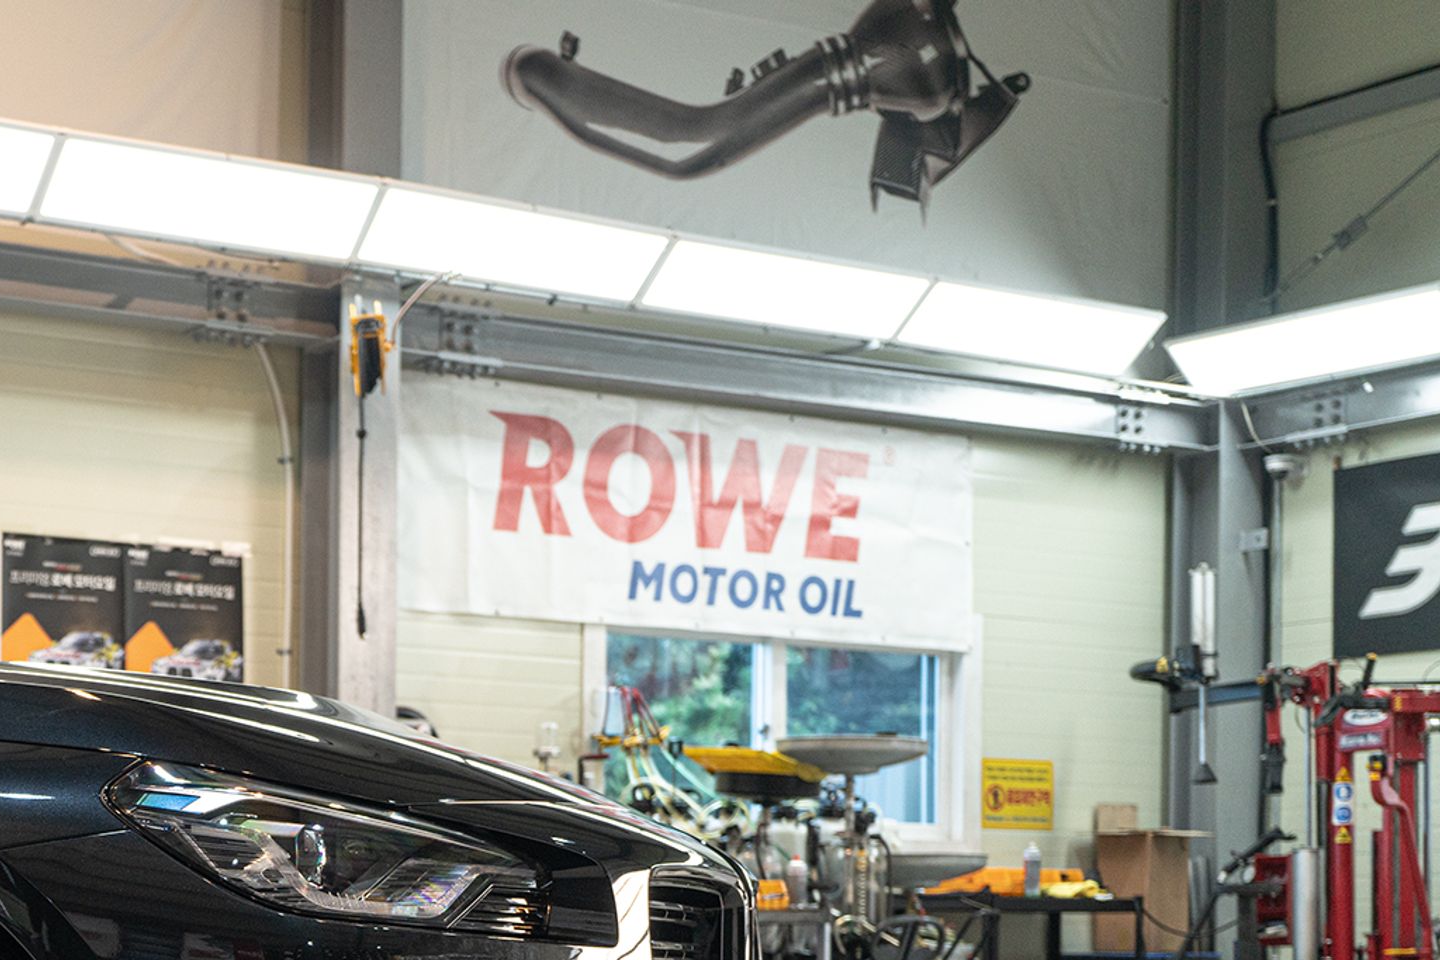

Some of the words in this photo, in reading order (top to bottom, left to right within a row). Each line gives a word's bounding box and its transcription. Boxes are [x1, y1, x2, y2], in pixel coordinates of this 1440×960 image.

[489, 409, 870, 563] ROWE
[627, 560, 786, 612] MOTOR
[798, 576, 864, 619] OIL
